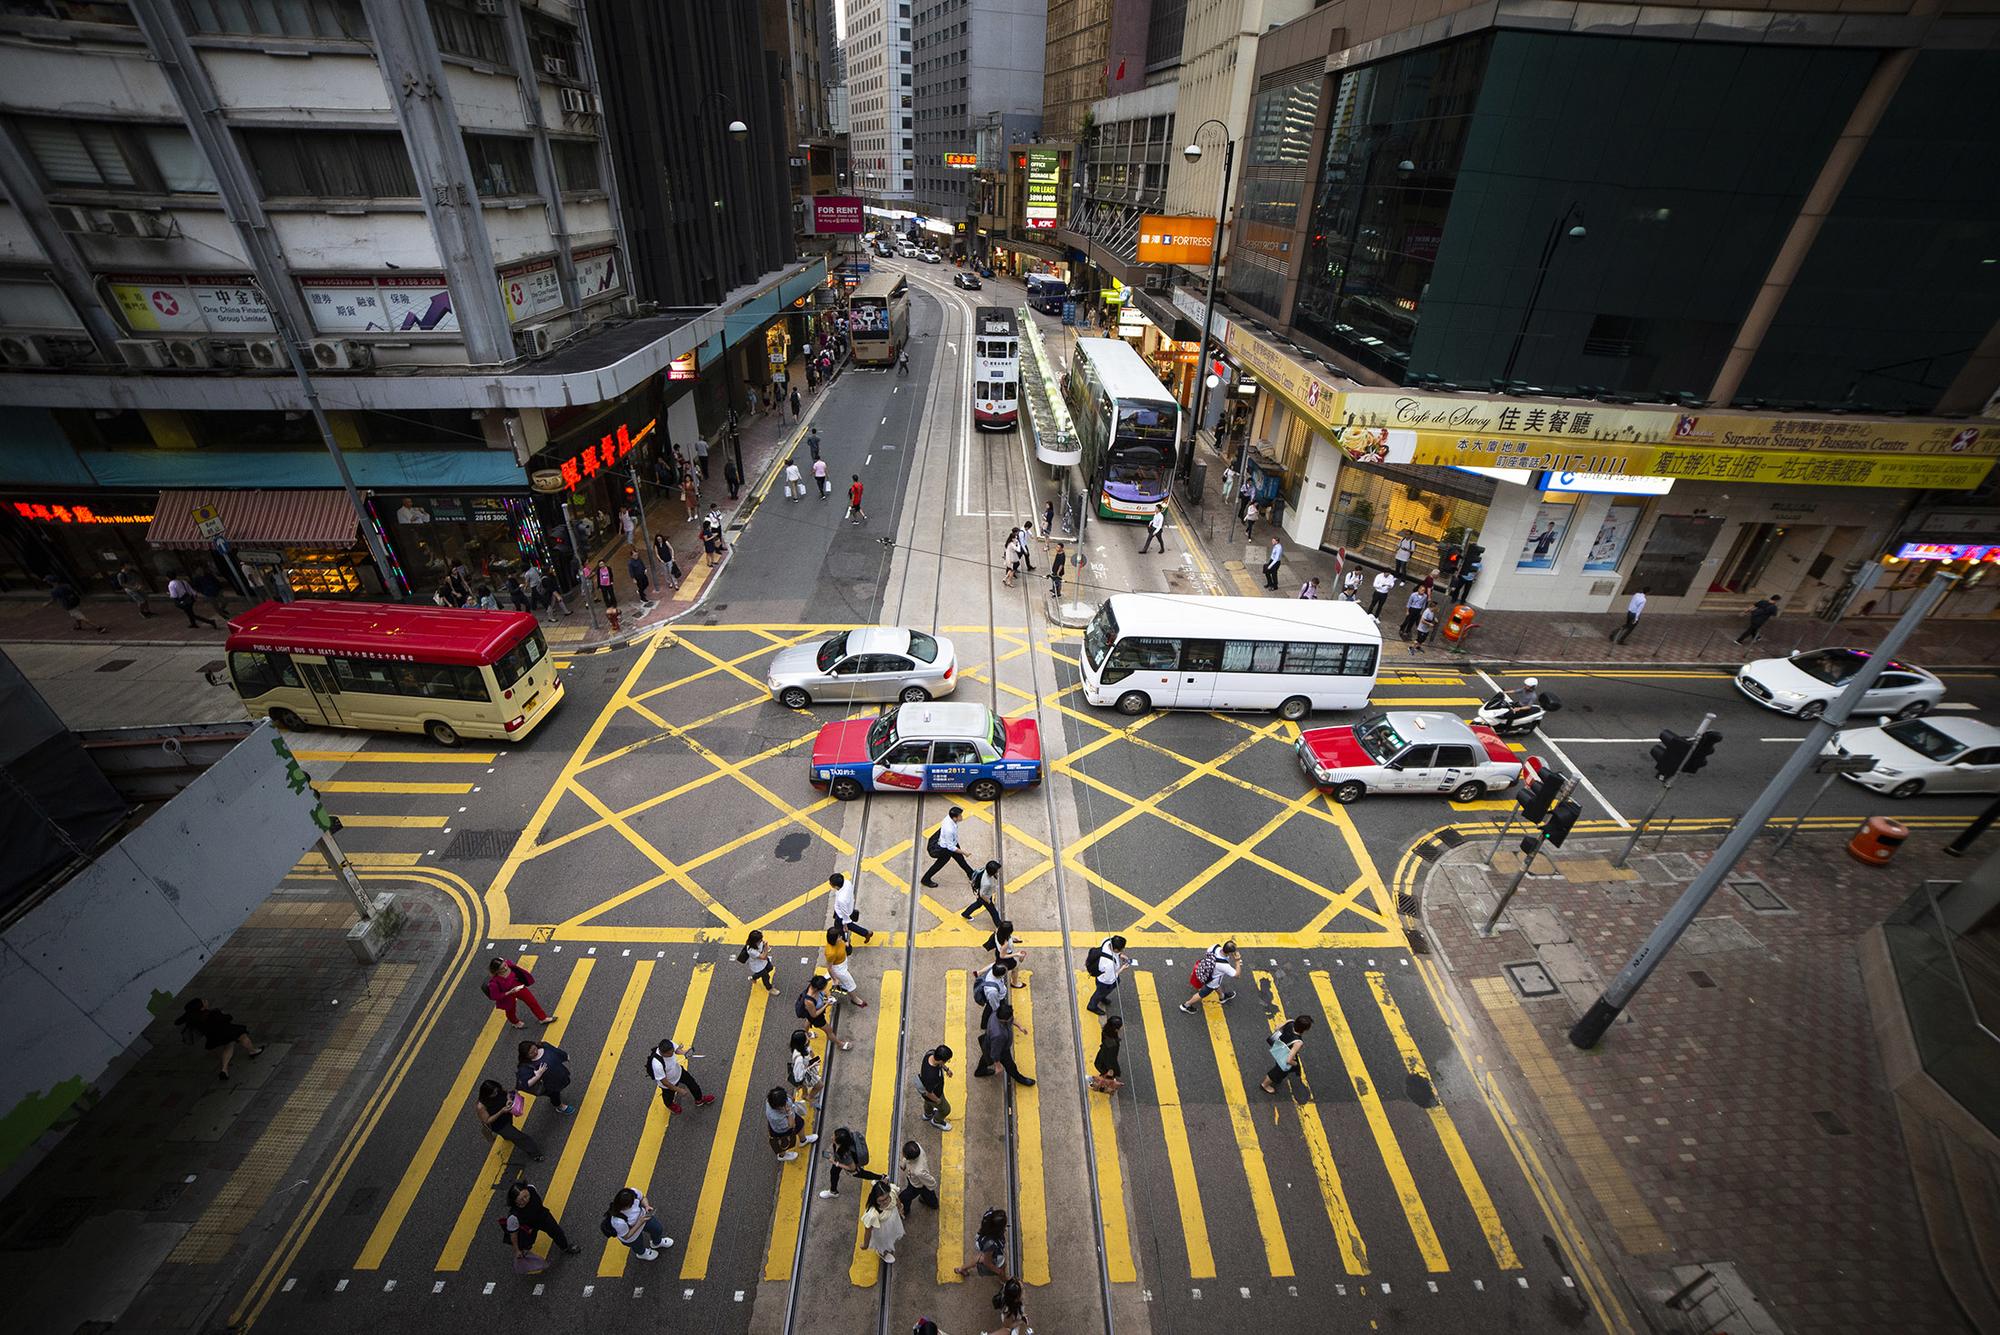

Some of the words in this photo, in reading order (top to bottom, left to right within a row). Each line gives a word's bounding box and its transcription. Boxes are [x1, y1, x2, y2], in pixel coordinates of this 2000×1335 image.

[1041, 186, 1056, 194] LEASE
[1038, 220, 1054, 228] KFC
[1172, 235, 1212, 247] FORTRESS
[390, 293, 410, 304] 保險
[203, 306, 219, 314] One
[219, 306, 240, 314] China
[218, 315, 241, 323] Group
[1394, 397, 1431, 426] Café
[1431, 410, 1447, 423] de
[1447, 405, 1491, 432] Savoy
[1498, 406, 1594, 435] 佳美餐廳
[1721, 432, 1769, 448] Superior
[1771, 433, 1817, 450] Strategy
[1819, 435, 1868, 450] Business
[1870, 437, 1910, 451] Centre
[1918, 440, 1951, 452] CTR
[1539, 453, 1628, 474] 2117-1111
[114, 515, 134, 523] WAH
[253, 643, 272, 651] PUBLIC
[275, 645, 291, 653] LIGHT
[317, 648, 336, 656] SEATS
